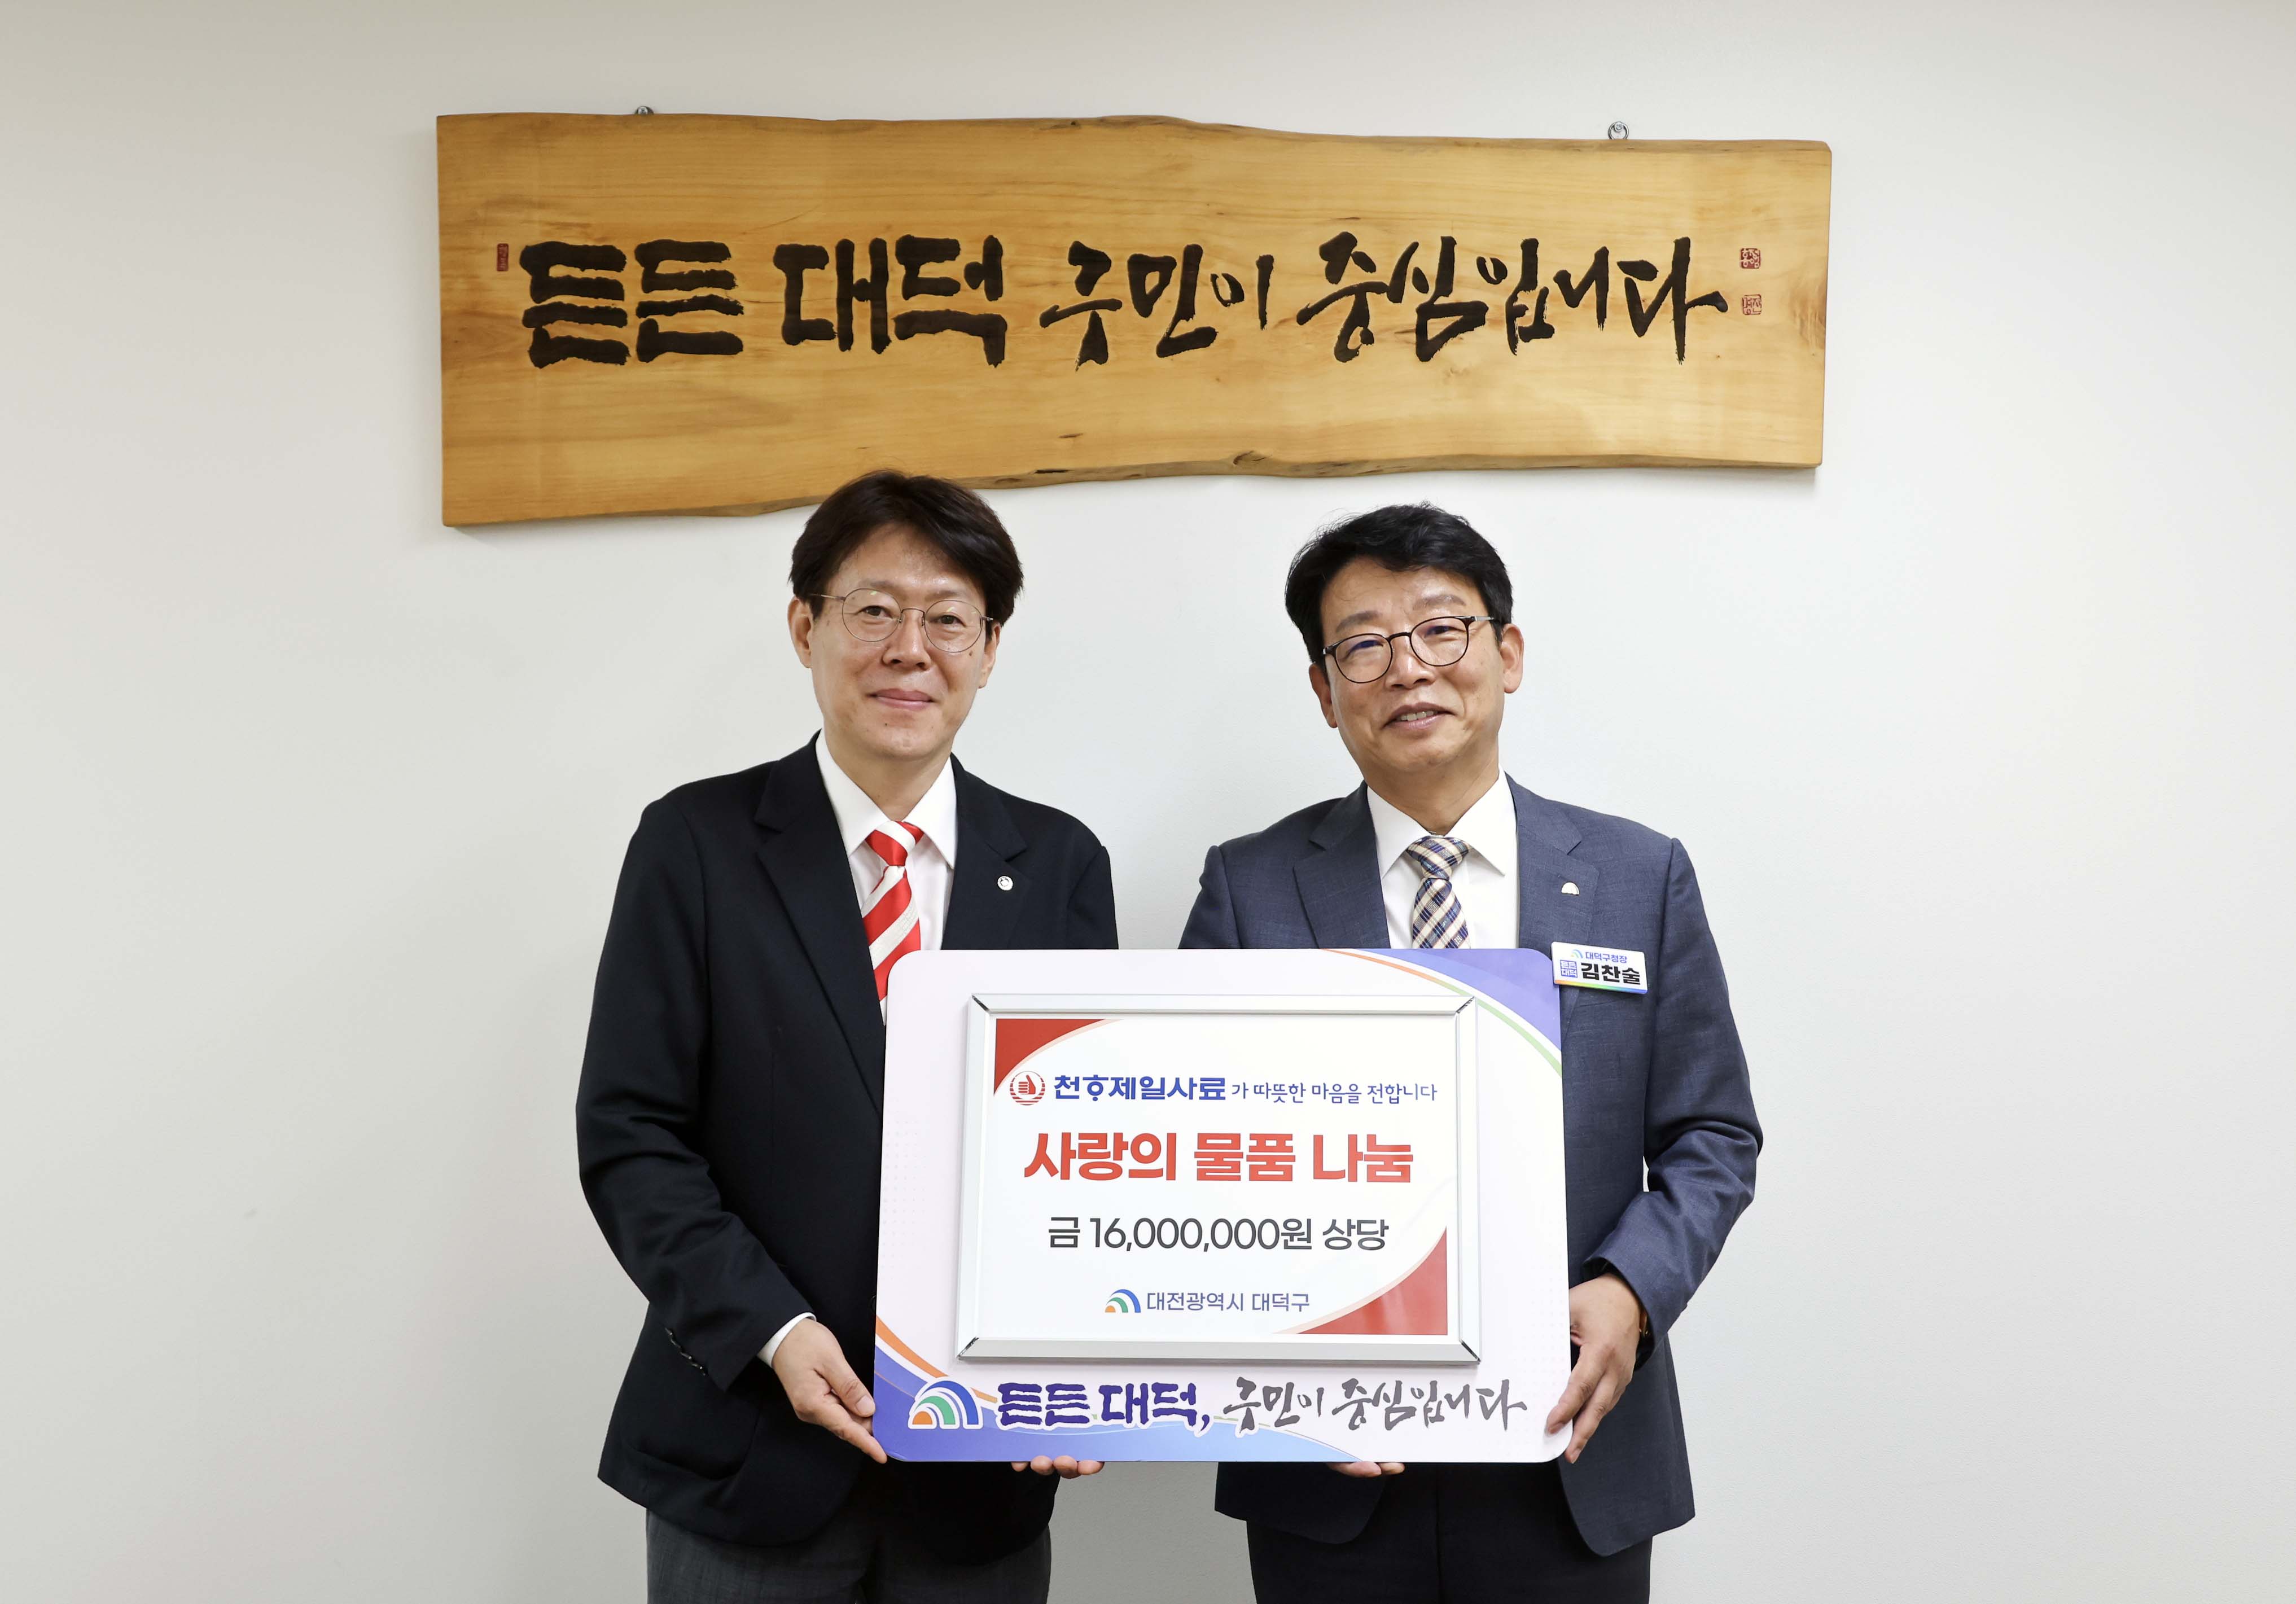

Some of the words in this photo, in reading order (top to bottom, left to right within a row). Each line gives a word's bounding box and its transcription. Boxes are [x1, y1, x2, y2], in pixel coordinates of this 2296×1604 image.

[520, 240, 743, 369] 든든
[774, 235, 1007, 367] 대덕
[1040, 242, 1274, 366] 주민이
[1297, 232, 1728, 362] 중심입니다
[1585, 952, 1627, 964] 대덕구청장
[1581, 962, 1640, 985] 김찬술
[1232, 1081, 1249, 1099] 가
[1253, 1081, 1306, 1103] 따뜻한
[1311, 1082, 1362, 1104] 마음을
[1367, 1083, 1438, 1104] 전합니다
[1024, 1132, 1177, 1181] 사랑의
[1194, 1133, 1296, 1182] 물품
[1313, 1134, 1413, 1183] 나눔
[1049, 1217, 1081, 1248] 금
[1090, 1217, 1312, 1252] 16,000,000원
[1322, 1219, 1390, 1251] 상당
[1147, 1292, 1244, 1312] 대전광역시
[1252, 1292, 1310, 1313] 대덕구
[998, 1382, 1090, 1427] 든든
[1099, 1382, 1210, 1431] 대덕,
[1223, 1376, 1325, 1434] 주민이
[1332, 1377, 1528, 1431] 중심입니다
